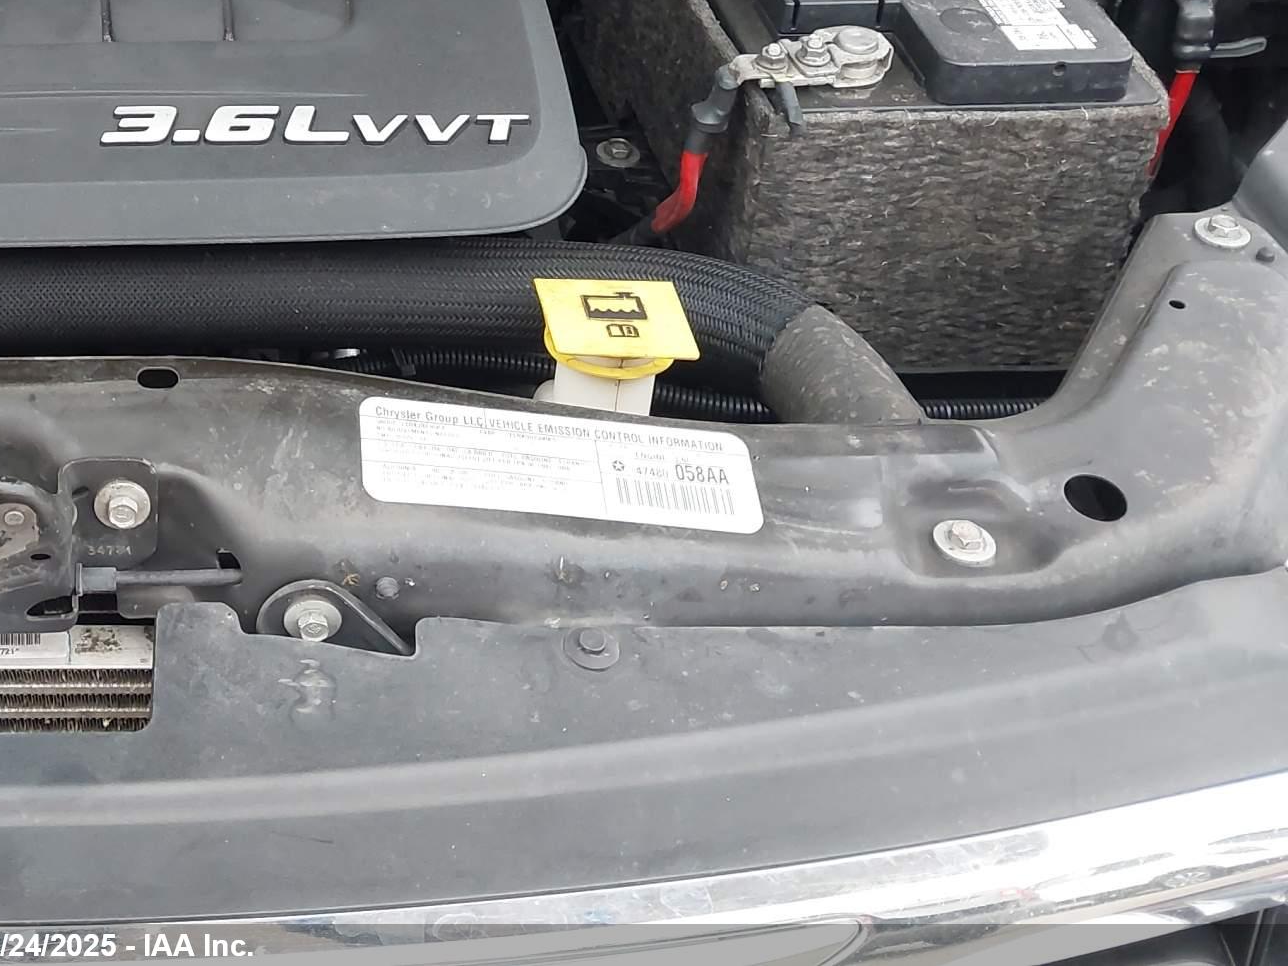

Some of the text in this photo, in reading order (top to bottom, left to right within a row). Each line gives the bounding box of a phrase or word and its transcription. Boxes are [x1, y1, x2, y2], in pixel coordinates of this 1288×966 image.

[375, 406, 422, 421] Chrysler
[425, 411, 459, 426] Group
[463, 416, 485, 428] LLC
[489, 419, 533, 433] VEHICLE
[537, 423, 591, 438] EMISSION
[593, 428, 645, 444] CONTROL
[648, 435, 724, 452] INFORMATION
[675, 464, 730, 485] 058AA
